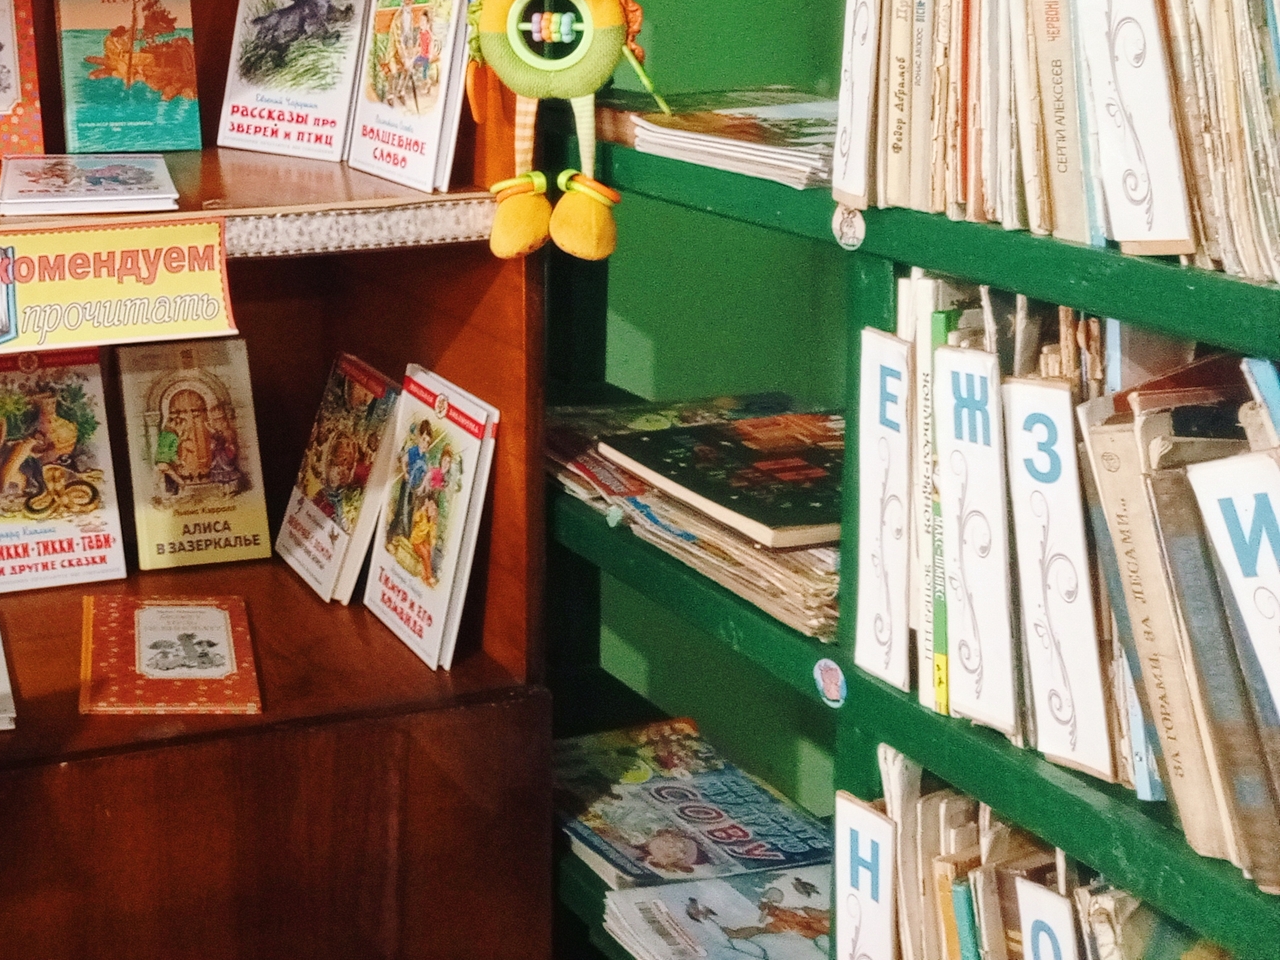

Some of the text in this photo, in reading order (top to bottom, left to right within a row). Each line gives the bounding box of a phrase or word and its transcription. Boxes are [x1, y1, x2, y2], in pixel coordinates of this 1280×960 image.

[1045, 0, 1060, 41] ЧЕРВОНІ
[361, 124, 427, 156] ВОЛШЕБНОЕ
[373, 149, 407, 169] СЛОВО
[20, 292, 221, 345] прочитать
[879, 364, 902, 433] Е
[951, 371, 992, 447] Ж
[156, 534, 261, 555] В ЗАЗЕРКАЛЬЕ
[182, 520, 232, 536] АЛИСА
[1217, 492, 1280, 578] И
[10, 560, 57, 576] ДРУГИЕ
[849, 827, 880, 904] Н
